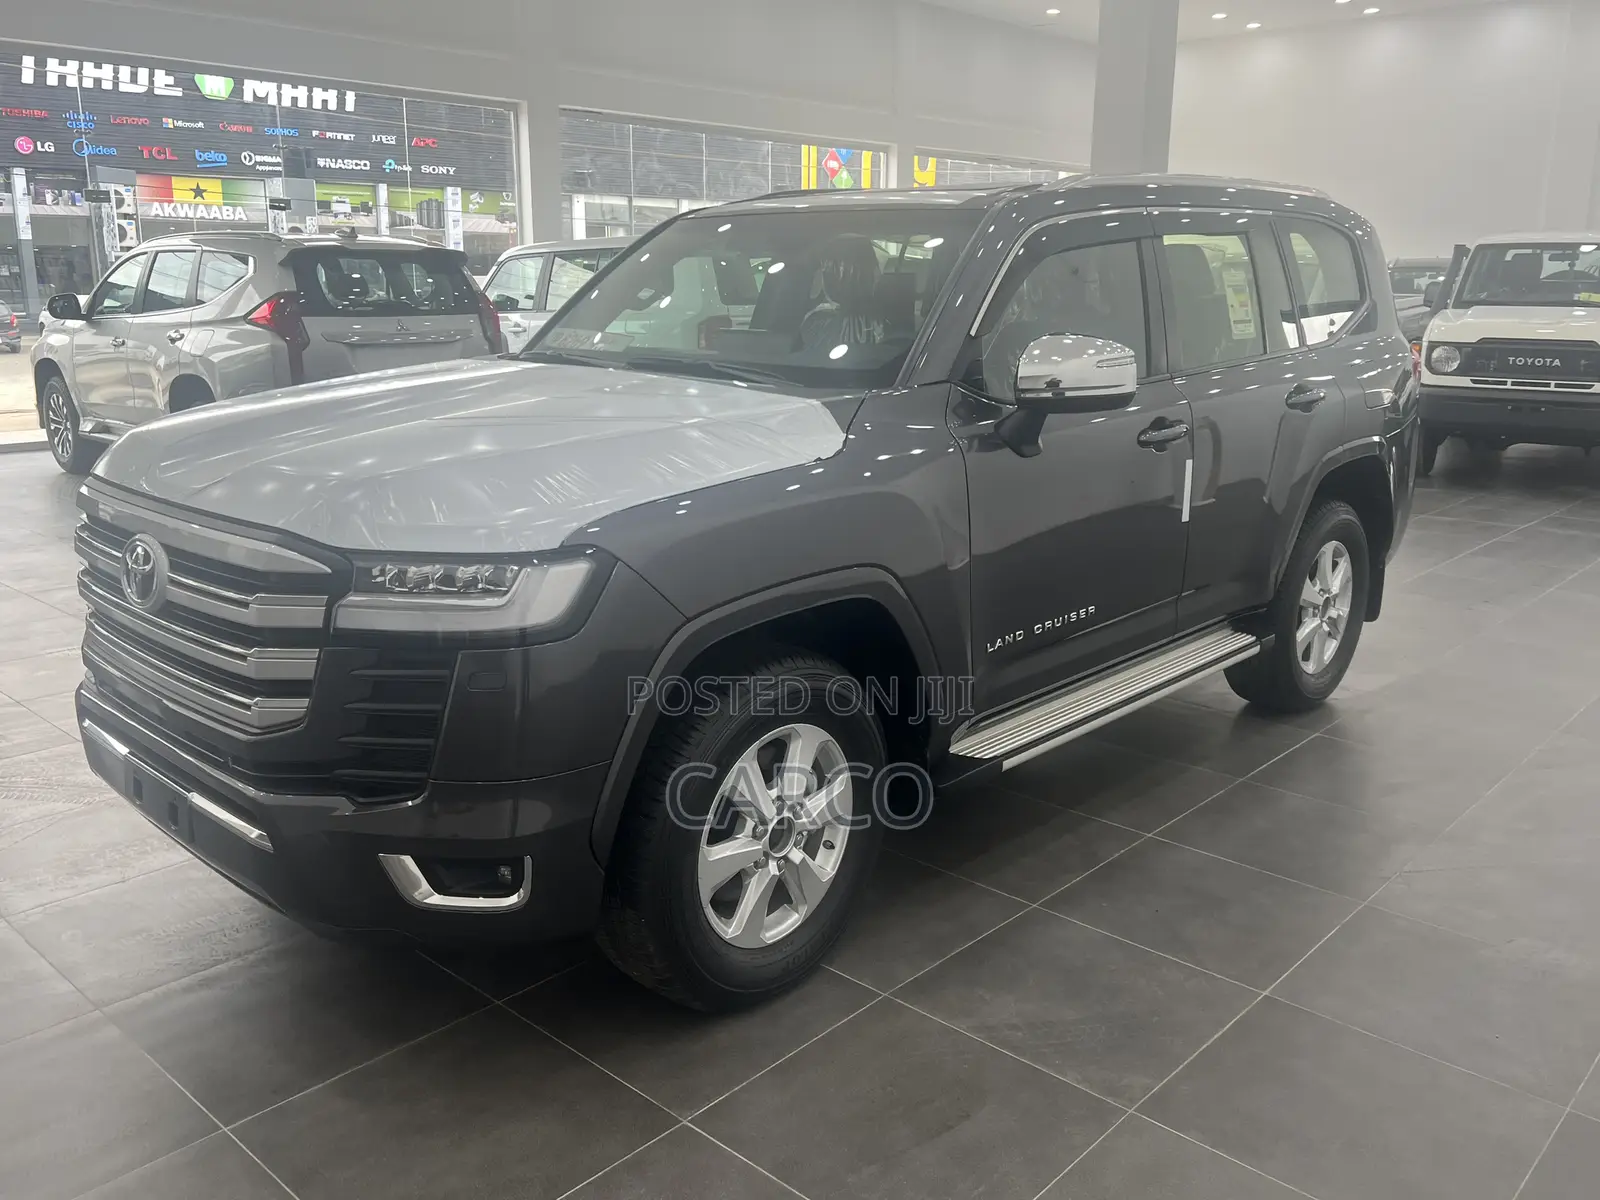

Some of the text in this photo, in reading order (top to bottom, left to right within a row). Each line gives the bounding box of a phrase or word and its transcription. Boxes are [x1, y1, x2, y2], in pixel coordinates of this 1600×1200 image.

[1, 107, 48, 118] TOSHIBA
[174, 120, 205, 129] Microsoft
[264, 127, 299, 137] SOPHOS
[36, 141, 55, 152] LG
[139, 146, 178, 160] TCL
[195, 149, 228, 162] beko
[325, 158, 370, 170] NASCO
[421, 165, 456, 175] SONY
[150, 202, 248, 221] AKWAABA
[1508, 357, 1561, 367] TOYOTA
[987, 605, 1096, 653] LAND CRUISER
